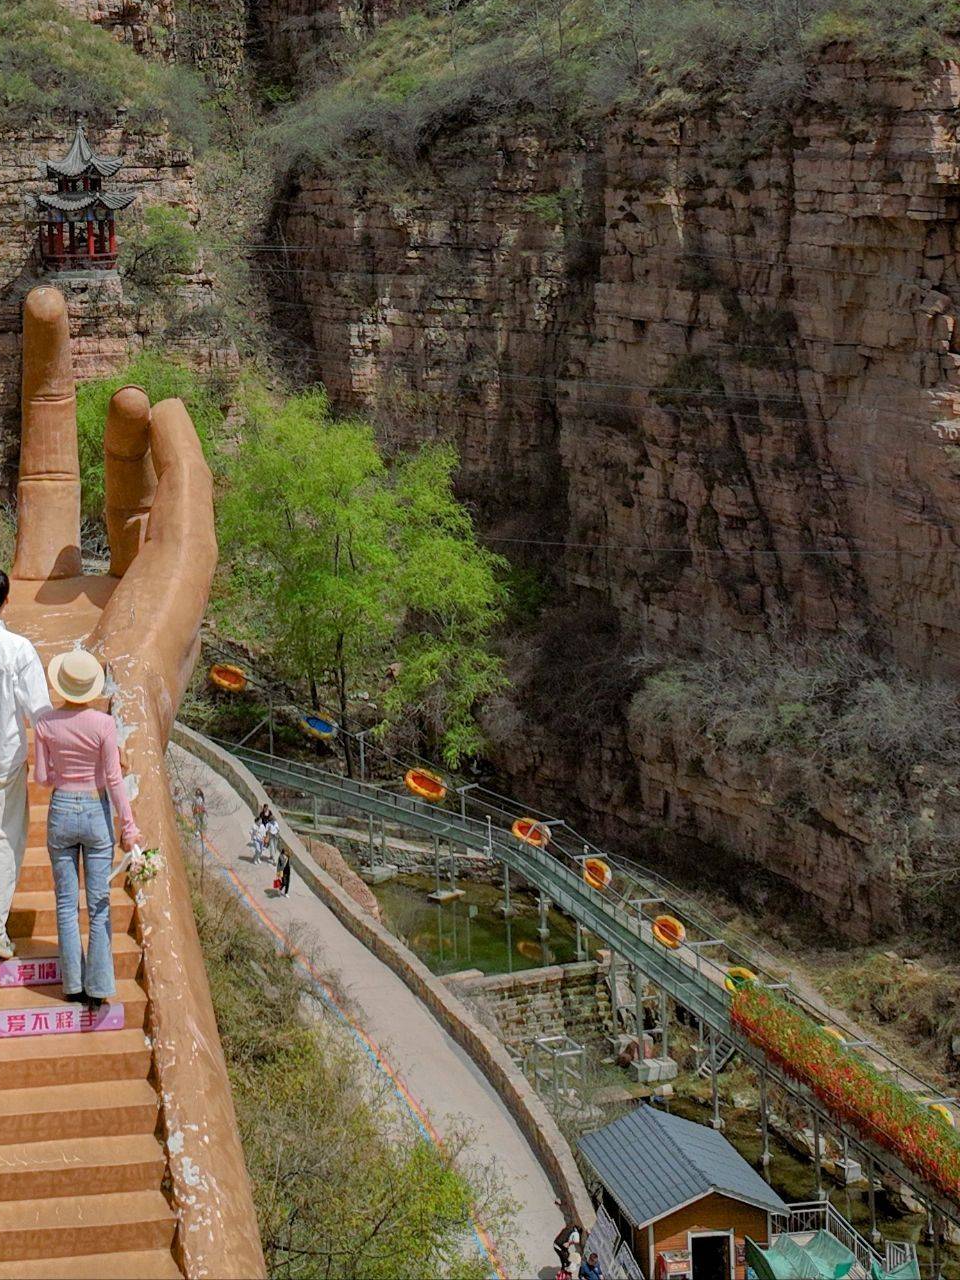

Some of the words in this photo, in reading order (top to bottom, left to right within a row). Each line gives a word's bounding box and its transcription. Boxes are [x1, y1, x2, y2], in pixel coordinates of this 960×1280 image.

[17, 962, 62, 980] 爱情
[7, 1010, 97, 1032] 爱不释手
